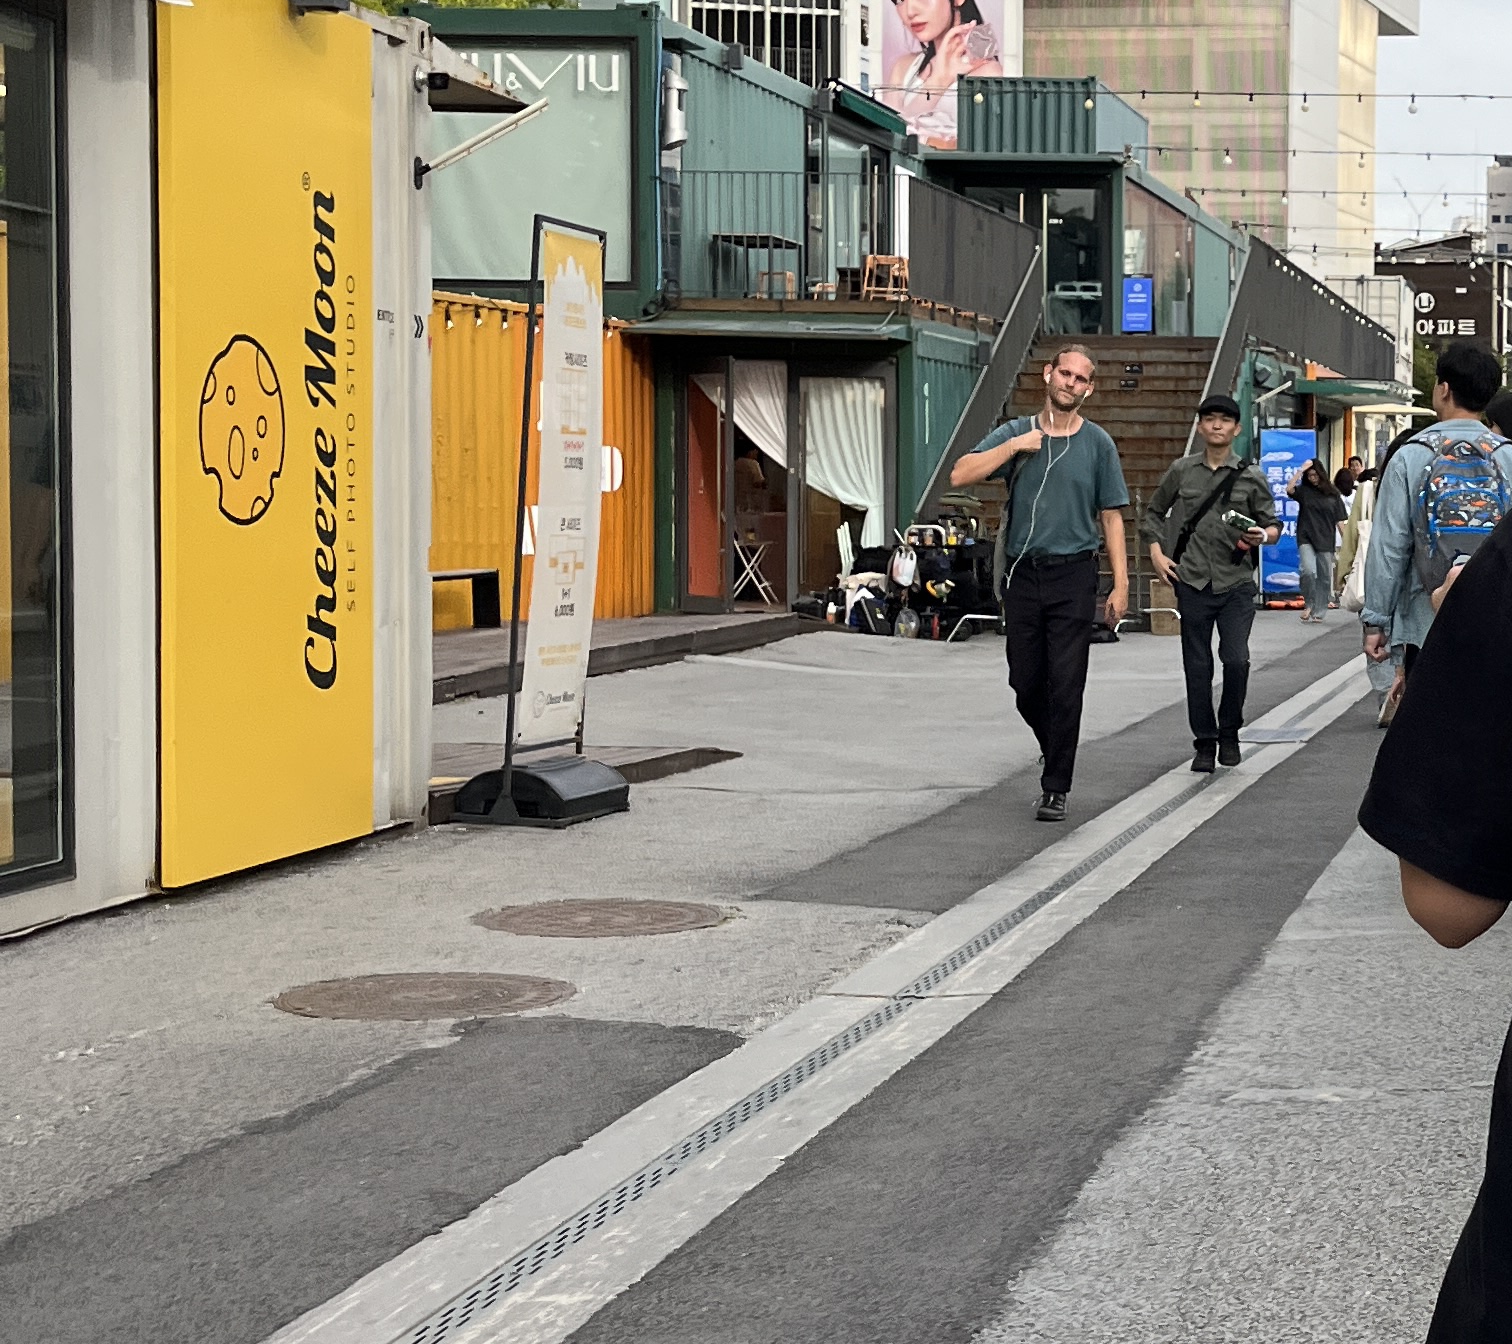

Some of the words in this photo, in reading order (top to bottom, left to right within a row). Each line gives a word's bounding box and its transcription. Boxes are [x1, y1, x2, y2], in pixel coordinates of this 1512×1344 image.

[345, 273, 357, 396] STUDIO
[1416, 319, 1476, 335] 아파트
[345, 411, 357, 522] PHOTO
[304, 426, 338, 690] Cheeze
[345, 539, 357, 613] SELF
